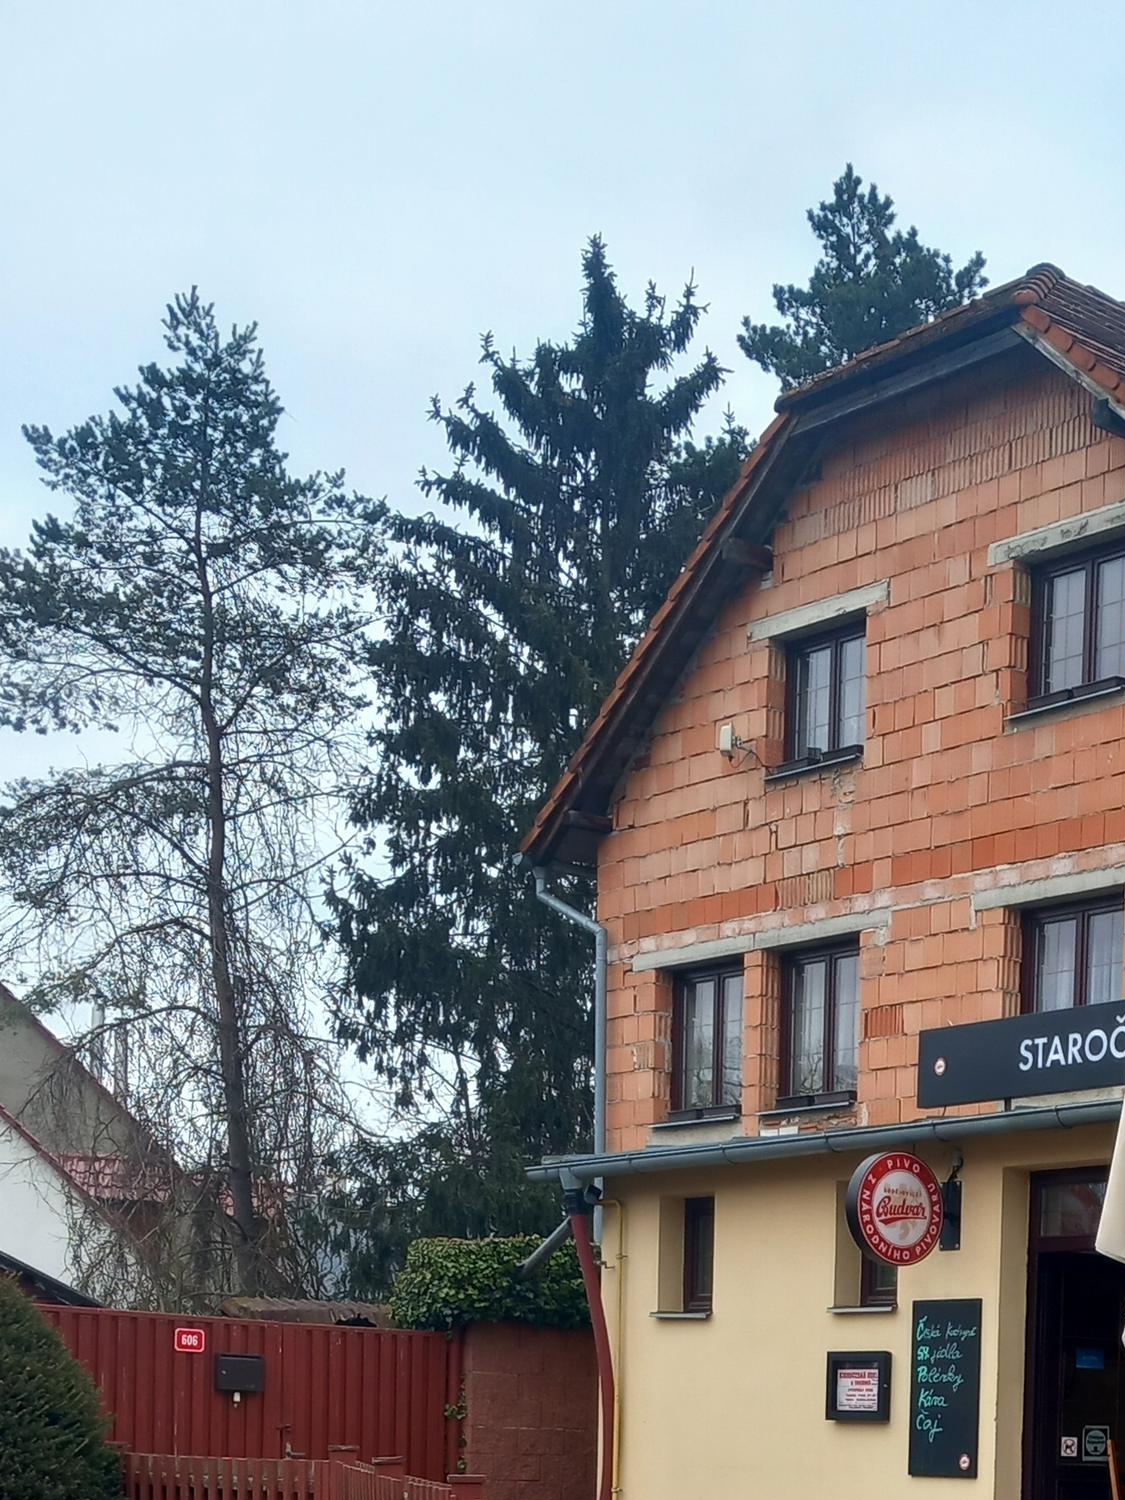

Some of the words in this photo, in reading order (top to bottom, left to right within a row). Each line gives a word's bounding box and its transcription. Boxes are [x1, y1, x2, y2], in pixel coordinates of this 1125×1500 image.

[876, 1195, 927, 1220] Budvar
[886, 1158, 921, 1173] PIVO
[915, 1183, 941, 1256] PIVOVARU
[181, 1334, 199, 1347] 606
[916, 1409, 943, 1443] Čaj
